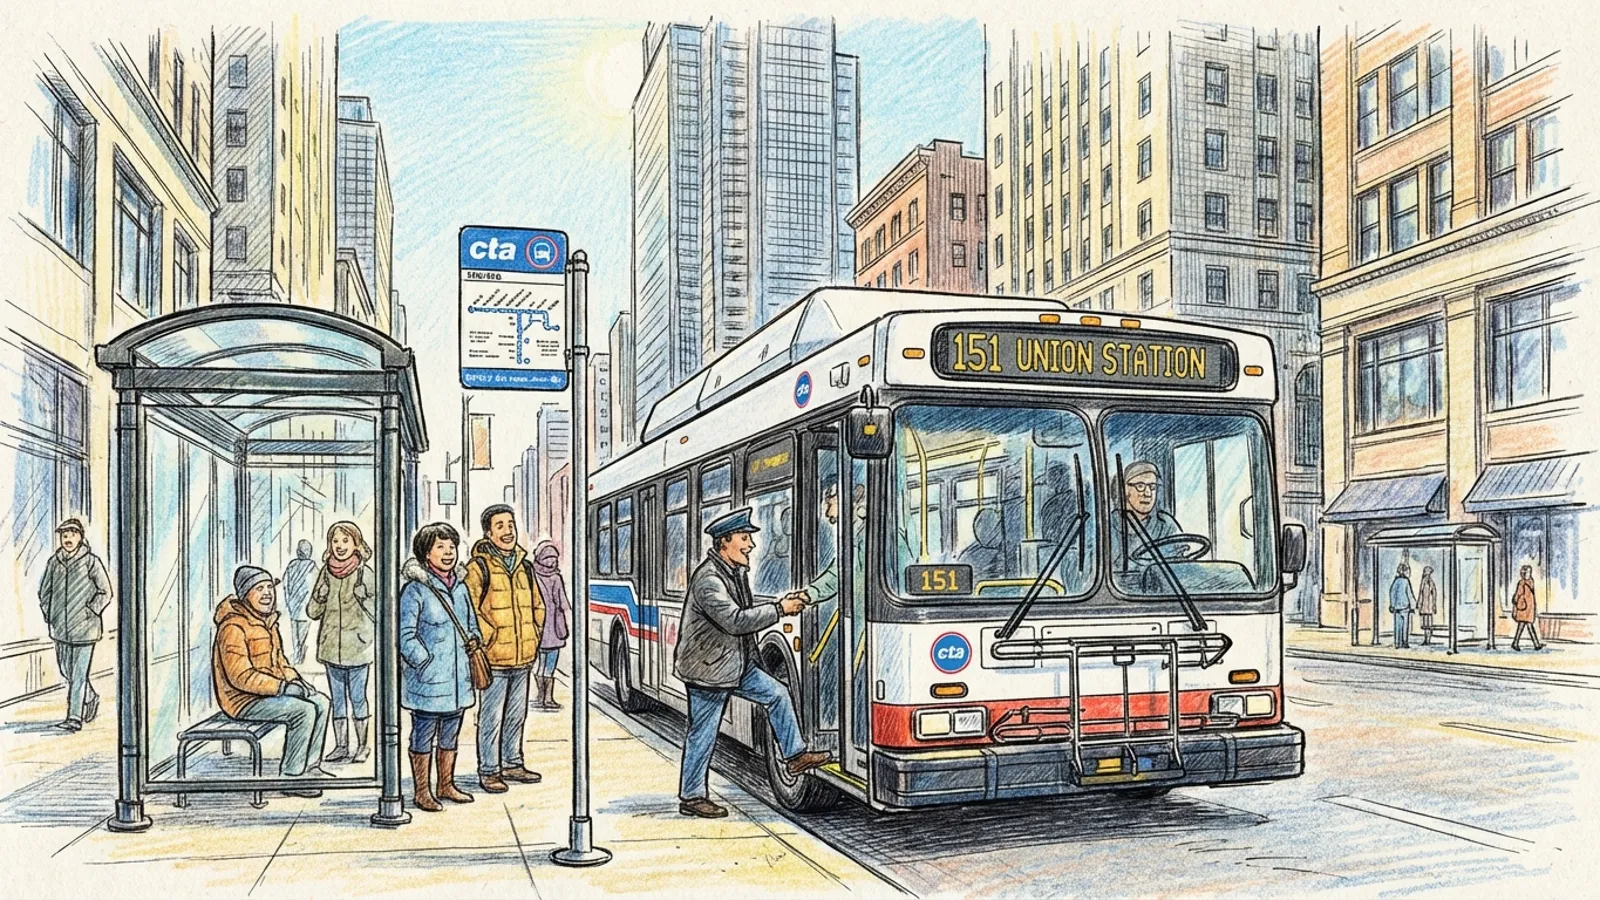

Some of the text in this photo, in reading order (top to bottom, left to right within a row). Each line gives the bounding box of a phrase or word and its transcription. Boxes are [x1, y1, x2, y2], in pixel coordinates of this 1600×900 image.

[469, 238, 517, 260] cta
[953, 333, 1206, 379] 151 UNION STATION
[921, 569, 958, 591] 151
[938, 646, 965, 659] cta
